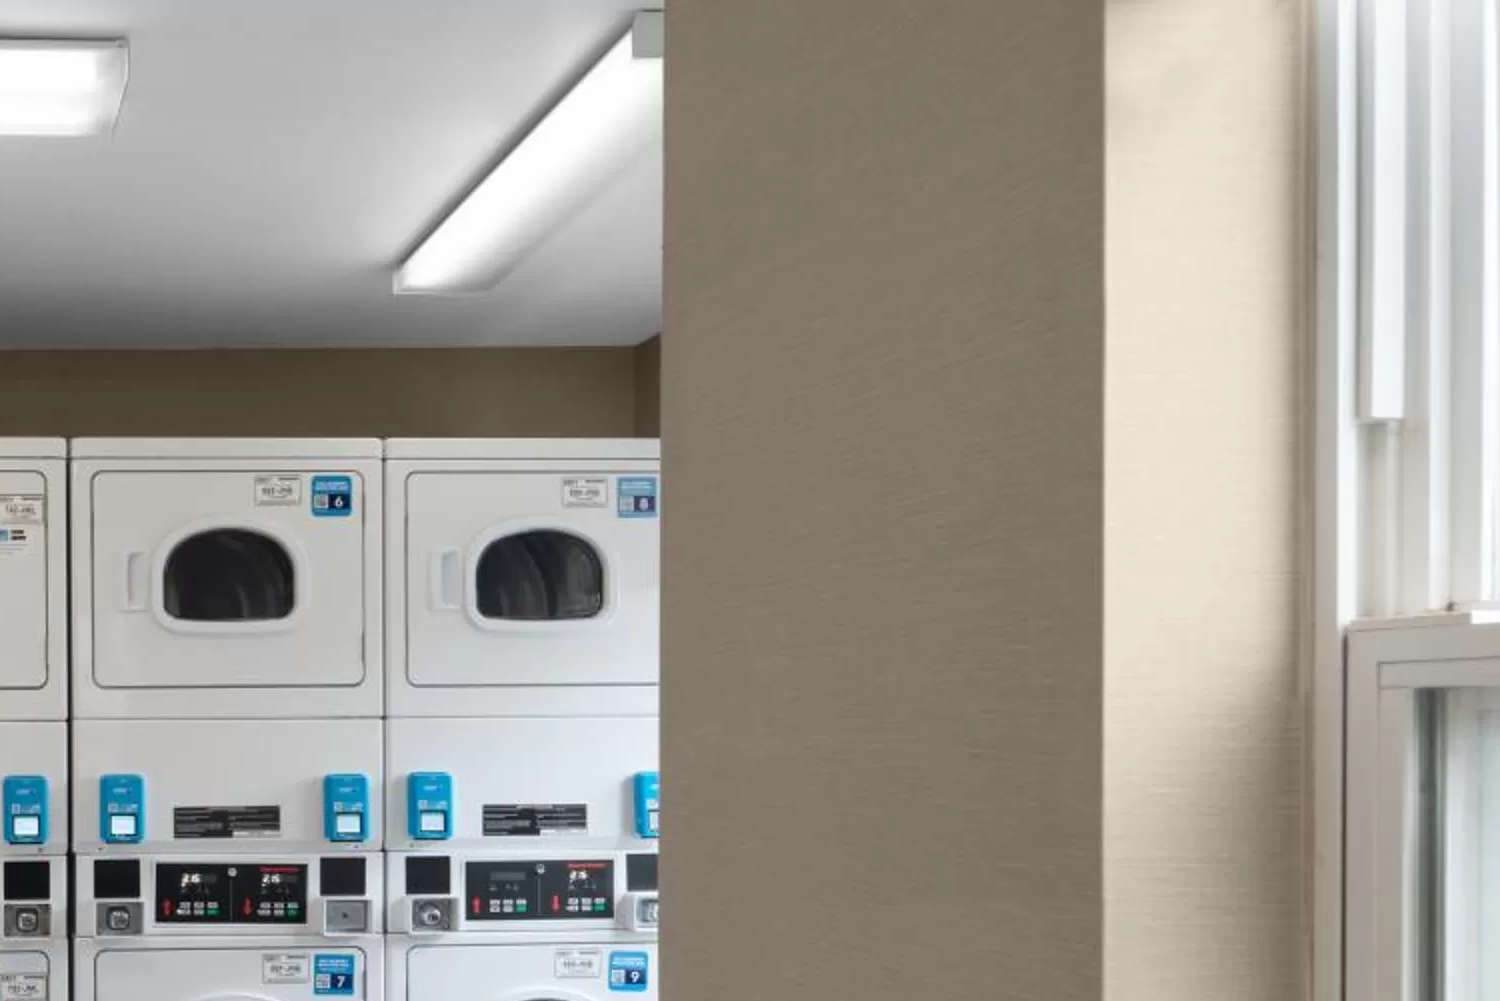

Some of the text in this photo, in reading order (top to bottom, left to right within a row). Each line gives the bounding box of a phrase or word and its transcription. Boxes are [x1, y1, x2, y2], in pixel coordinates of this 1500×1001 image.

[335, 496, 344, 508] 6
[336, 975, 346, 988] 7
[631, 971, 640, 983] 9
